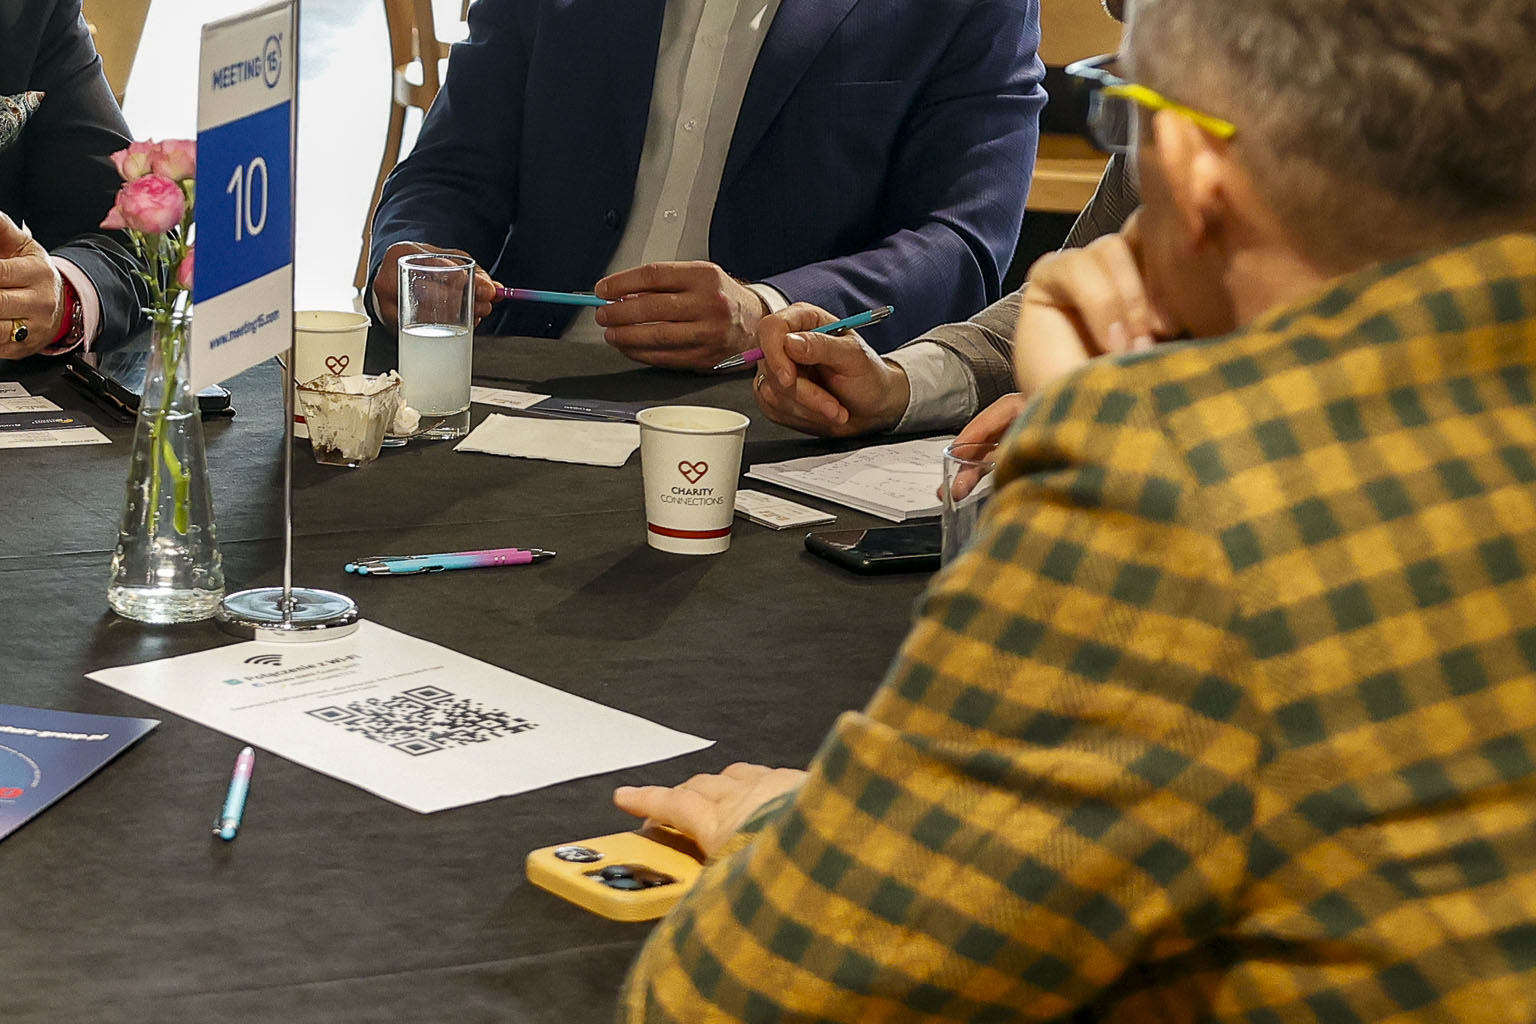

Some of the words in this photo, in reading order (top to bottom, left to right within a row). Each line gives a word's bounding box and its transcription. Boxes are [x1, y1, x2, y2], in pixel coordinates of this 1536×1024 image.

[212, 57, 262, 90] MEETING
[226, 156, 268, 241] 10
[210, 310, 280, 349] www.meeting15.com
[661, 494, 724, 506] CONNECTIONS
[671, 486, 714, 496] CHARITY
